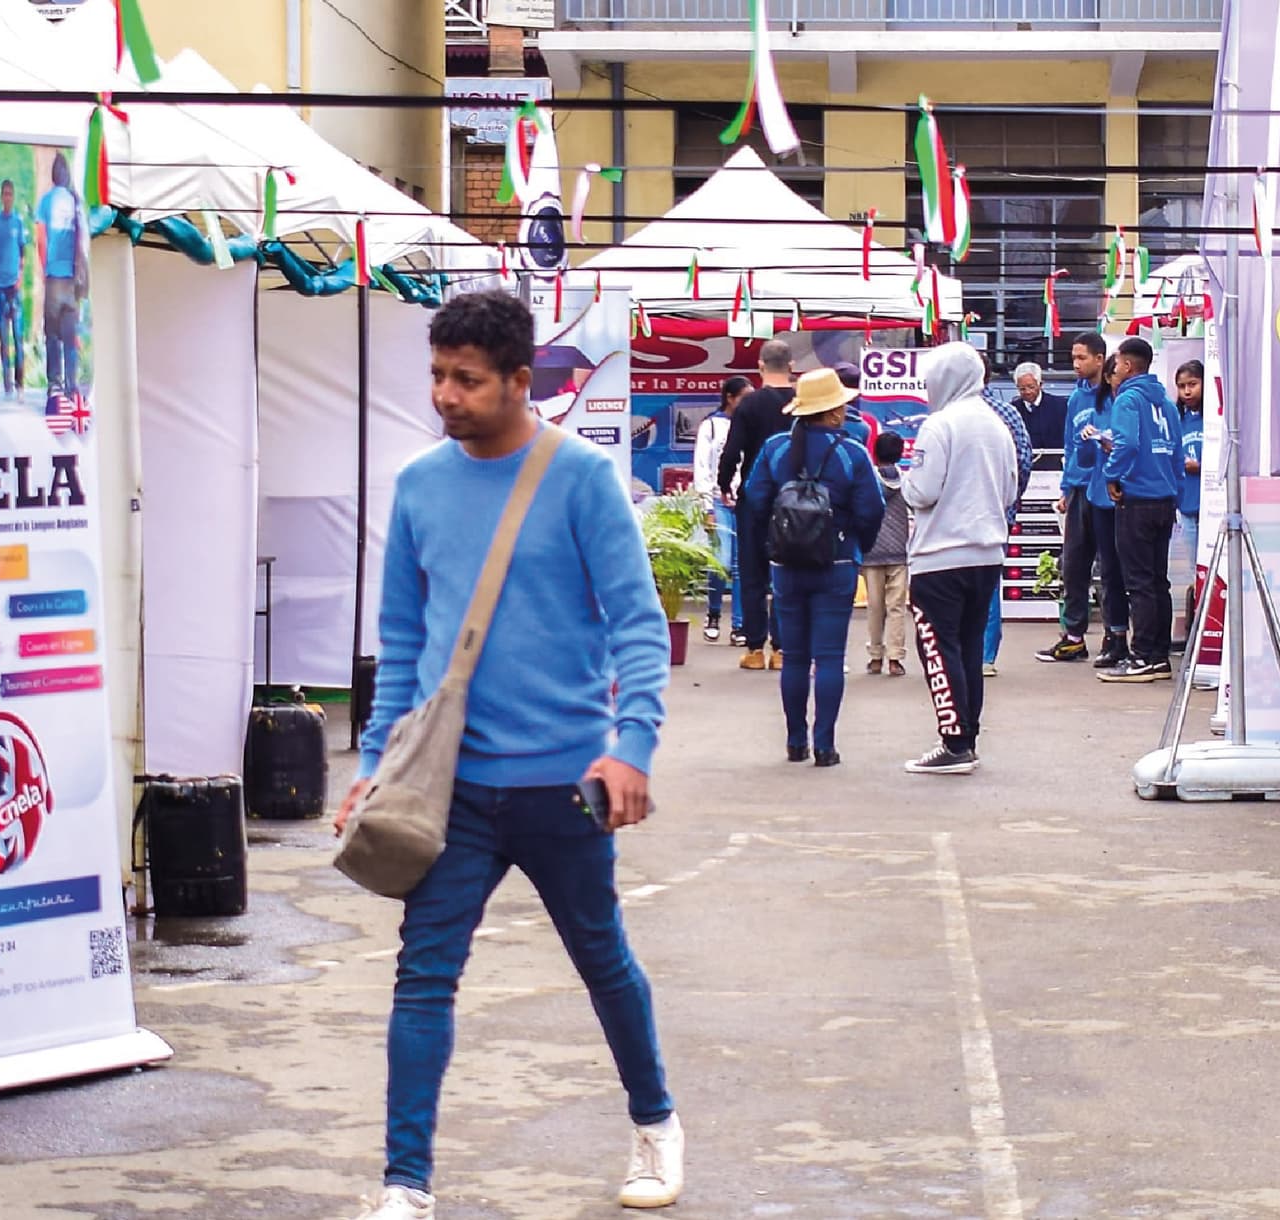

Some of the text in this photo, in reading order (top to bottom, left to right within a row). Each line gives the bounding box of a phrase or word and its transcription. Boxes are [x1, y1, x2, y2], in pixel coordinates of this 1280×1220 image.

[862, 351, 917, 378] GSI
[653, 379, 668, 389] la
[0, 783, 42, 826] cnela
